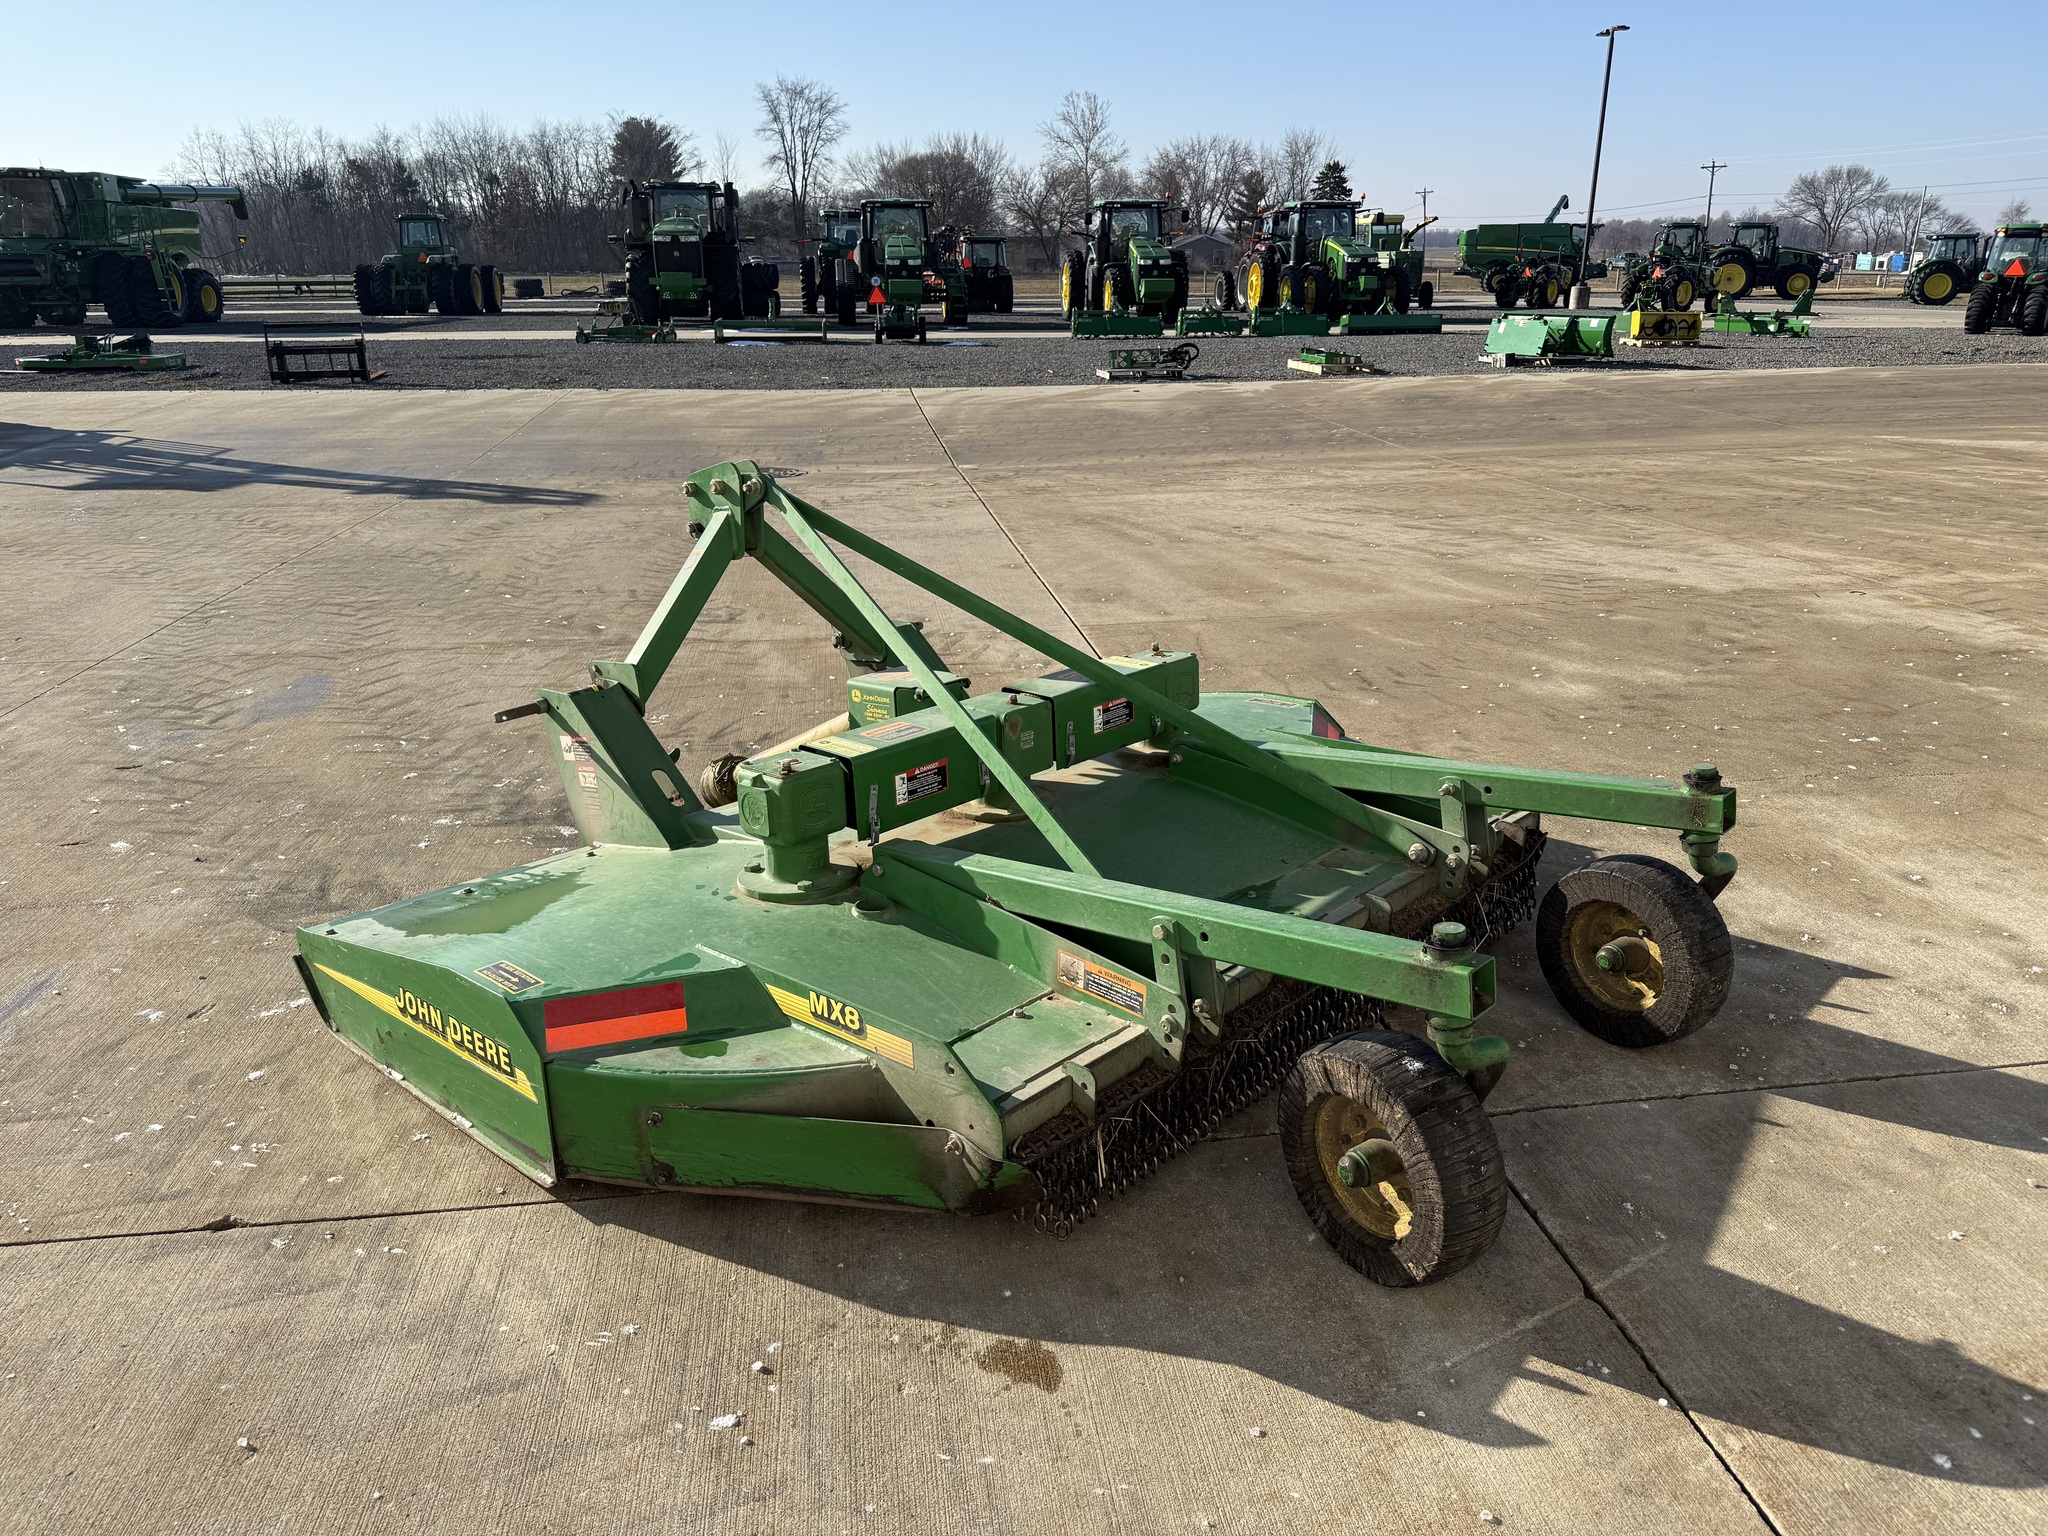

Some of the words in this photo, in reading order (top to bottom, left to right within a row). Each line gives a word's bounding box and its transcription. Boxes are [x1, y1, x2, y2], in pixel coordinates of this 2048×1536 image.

[920, 761, 939, 771] DANGER
[1104, 970, 1132, 987] WARNING
[809, 990, 862, 1032] MX8
[394, 986, 445, 1034] JOHN
[447, 1014, 514, 1076] DEERE
